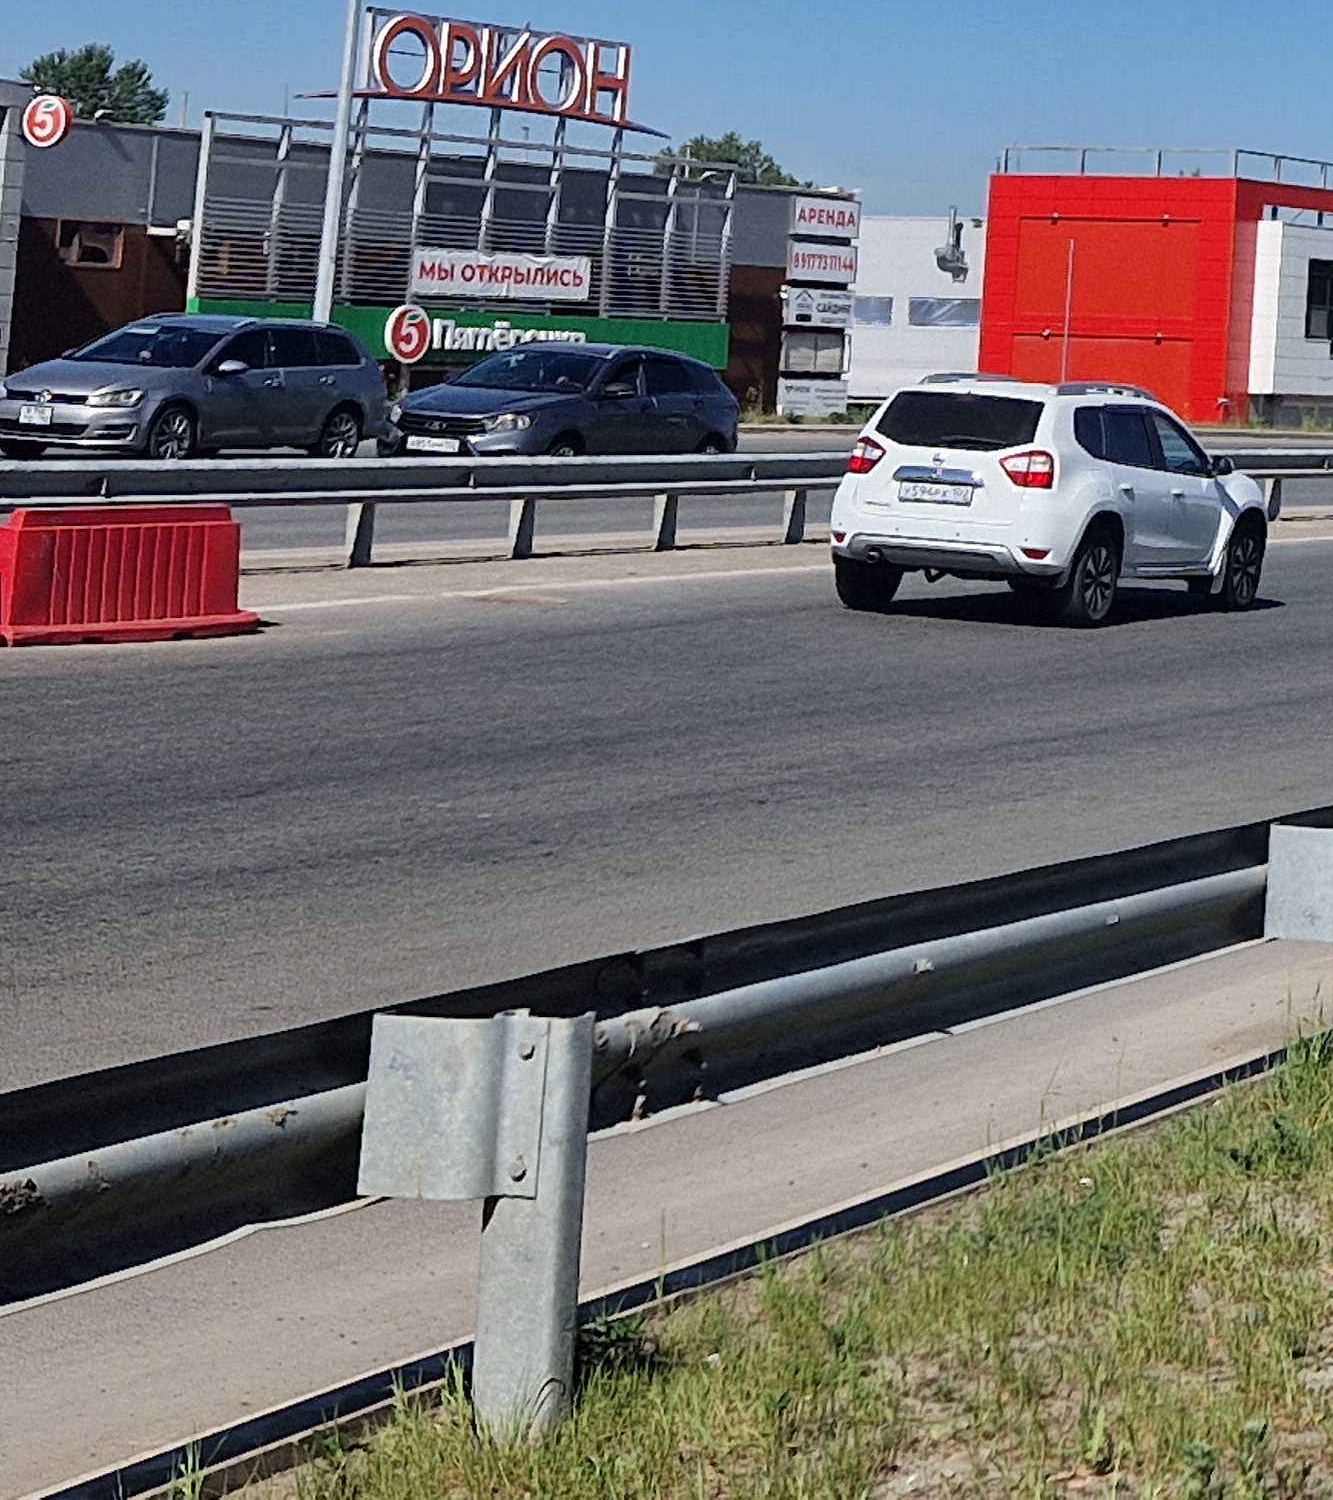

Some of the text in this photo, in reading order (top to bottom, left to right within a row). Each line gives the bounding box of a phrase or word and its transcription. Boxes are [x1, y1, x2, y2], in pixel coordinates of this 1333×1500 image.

[373, 14, 630, 122] ОРИОН
[797, 206, 857, 229] АРЕНДА
[417, 261, 584, 288] МЫ ОТКРЫЛИСЬ
